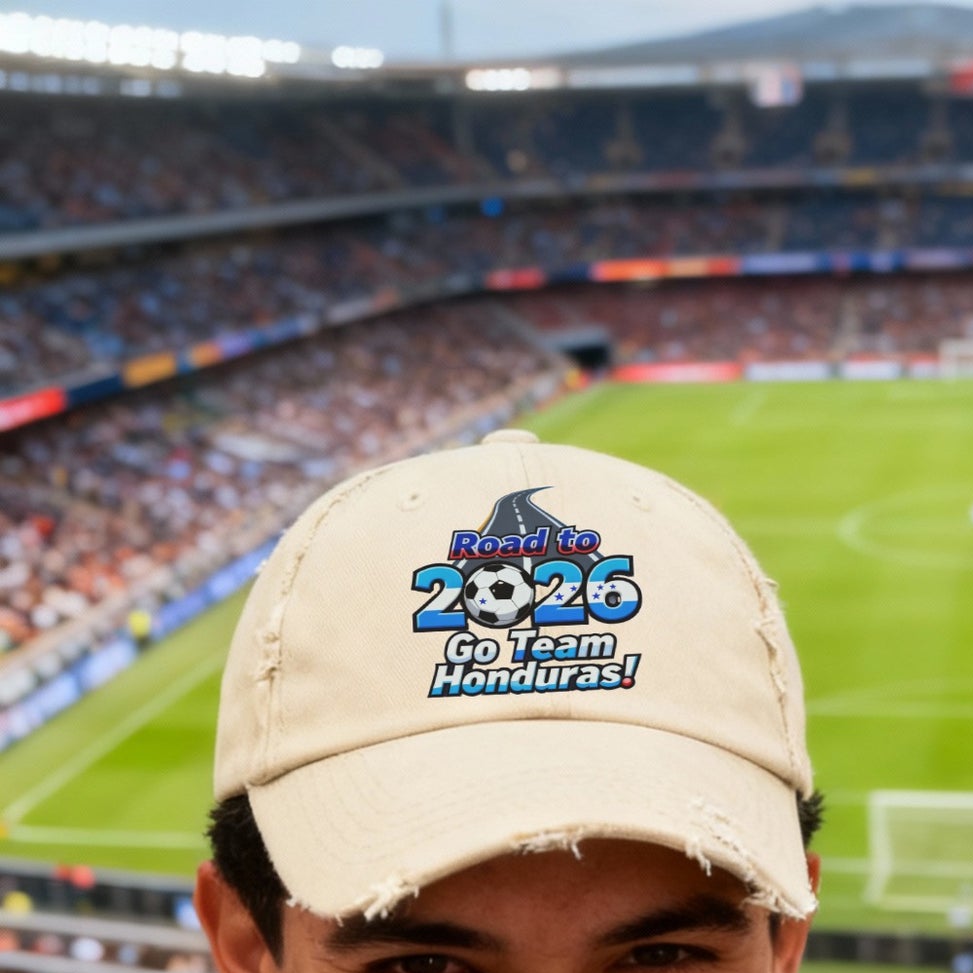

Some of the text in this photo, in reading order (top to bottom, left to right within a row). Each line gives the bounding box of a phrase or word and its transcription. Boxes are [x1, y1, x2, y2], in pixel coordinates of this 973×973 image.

[448, 525, 601, 560] Road to
[444, 628, 617, 665] Go Team
[427, 653, 642, 698] Honduras!
